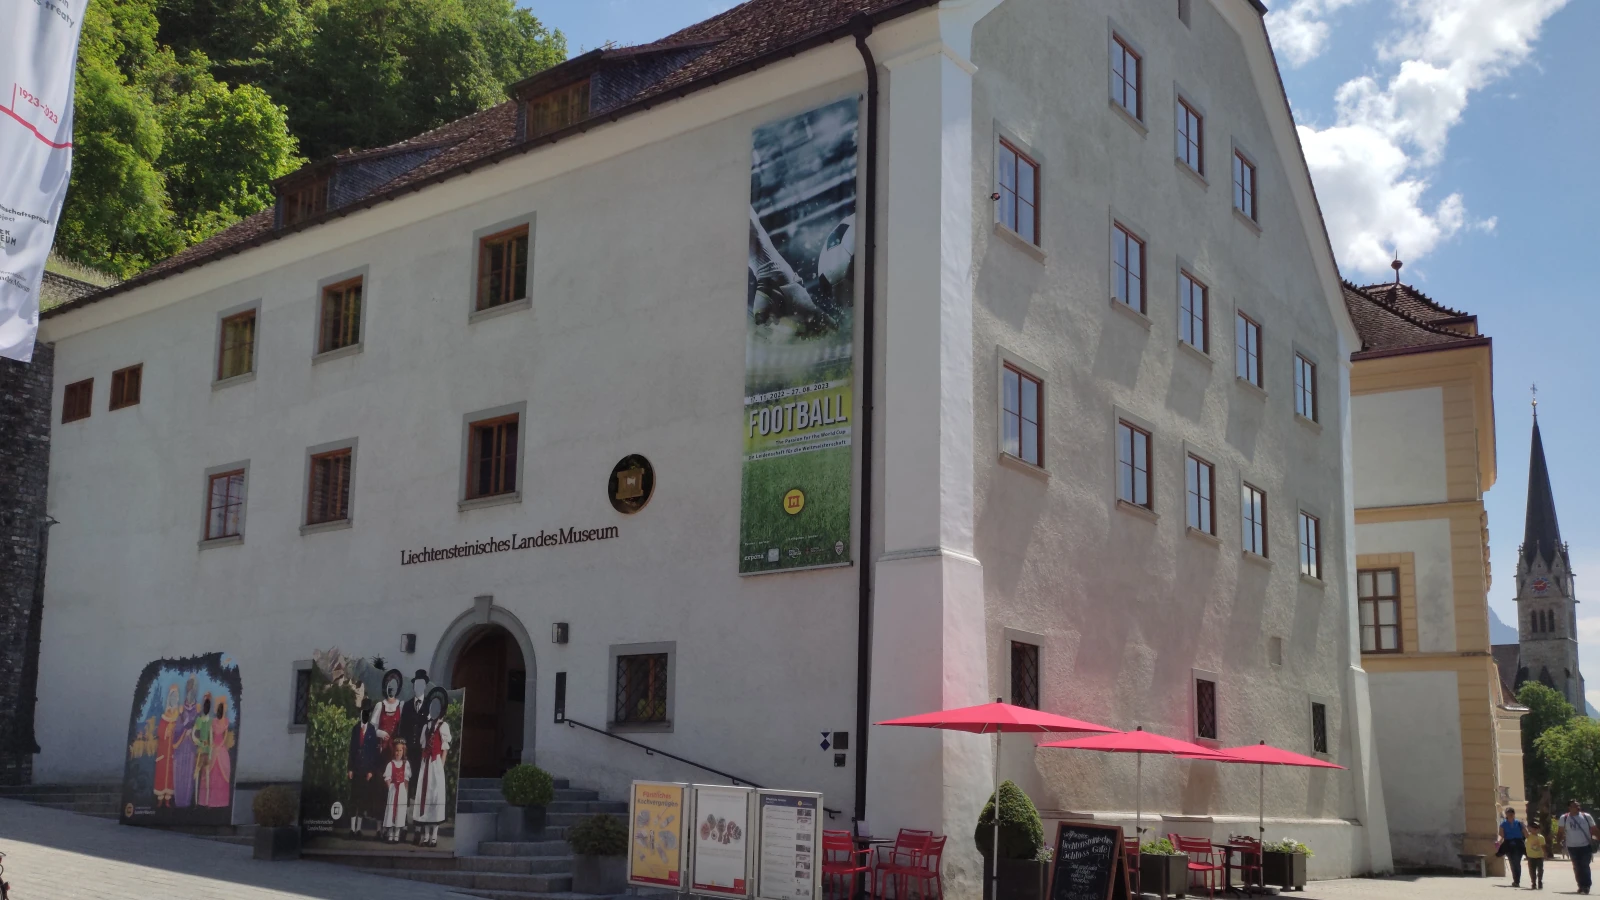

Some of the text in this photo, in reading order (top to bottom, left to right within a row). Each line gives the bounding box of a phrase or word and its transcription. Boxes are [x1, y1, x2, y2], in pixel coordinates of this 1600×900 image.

[45, 1, 75, 28] treaty
[814, 382, 829, 391] 2023
[749, 394, 848, 438] FOOTBALL
[821, 430, 835, 438] World
[755, 450, 785, 460] Leidenschaft
[802, 440, 846, 452] Weltmeisterschaft
[400, 536, 511, 566] Liechtensteinisches
